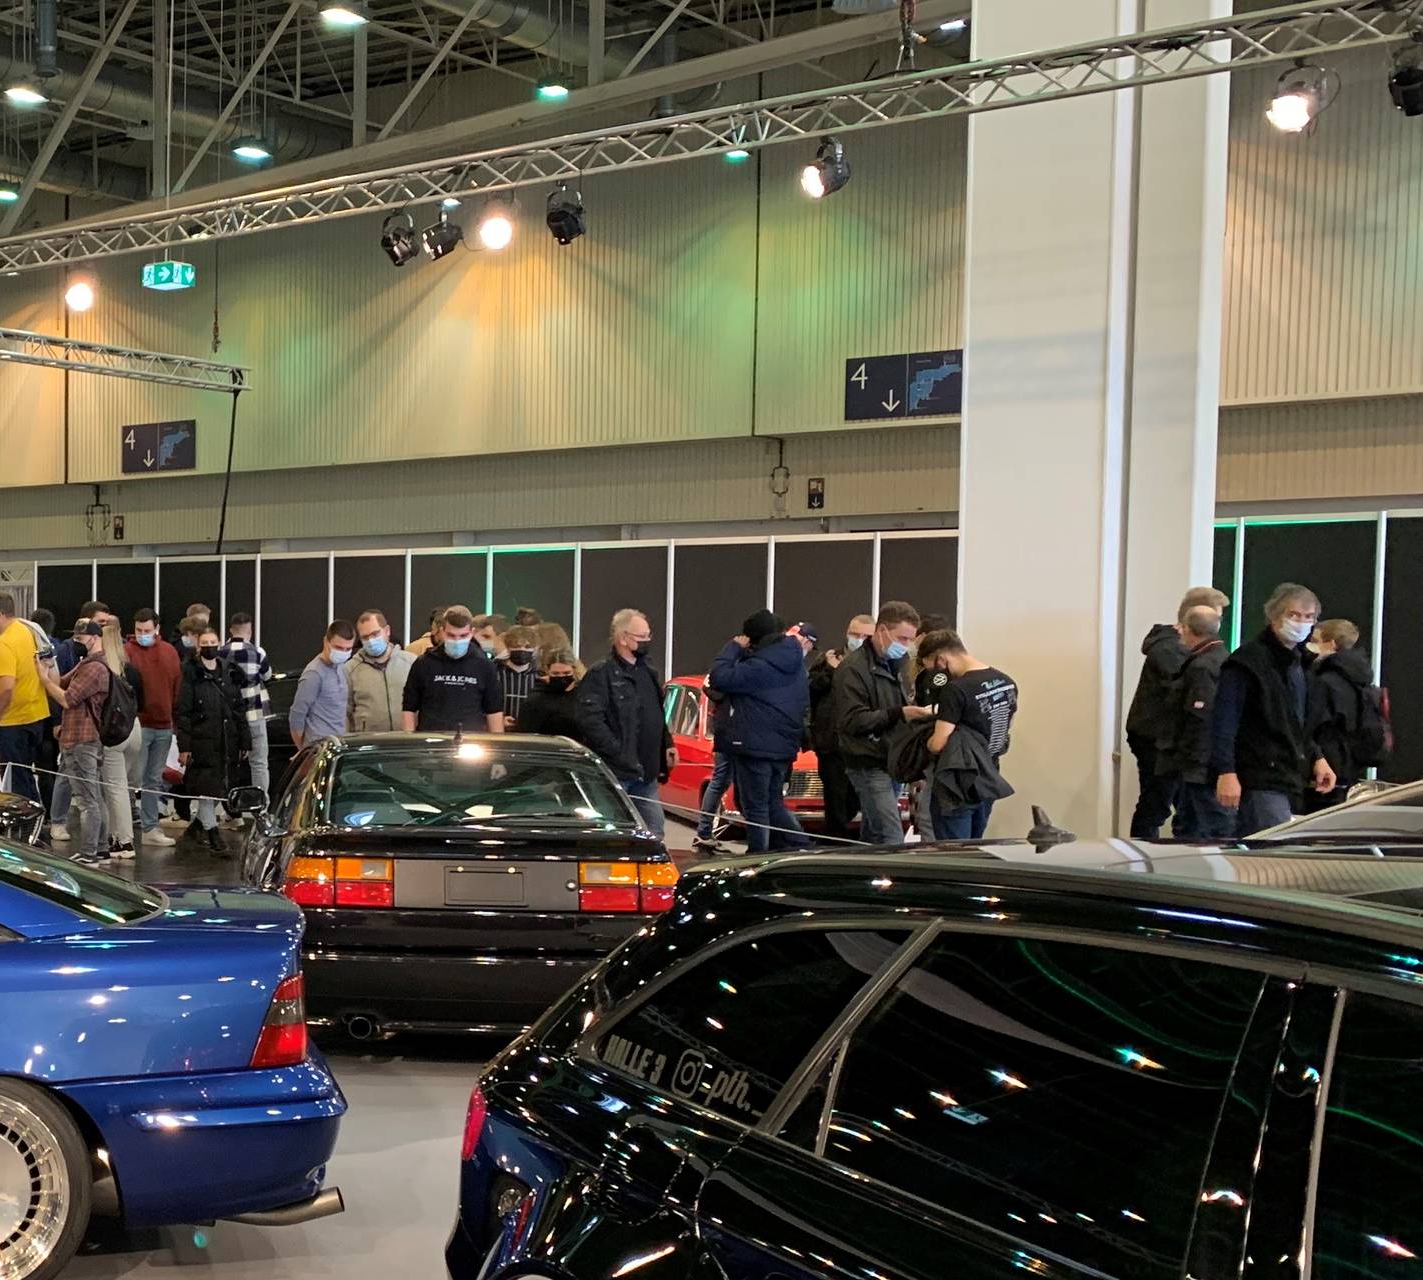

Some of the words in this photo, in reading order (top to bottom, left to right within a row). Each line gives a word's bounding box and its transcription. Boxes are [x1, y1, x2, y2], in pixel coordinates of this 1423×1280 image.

[850, 362, 869, 390] 4
[124, 428, 137, 451] 4
[603, 1034, 653, 1078] HALLE
[649, 1054, 667, 1085] 3
